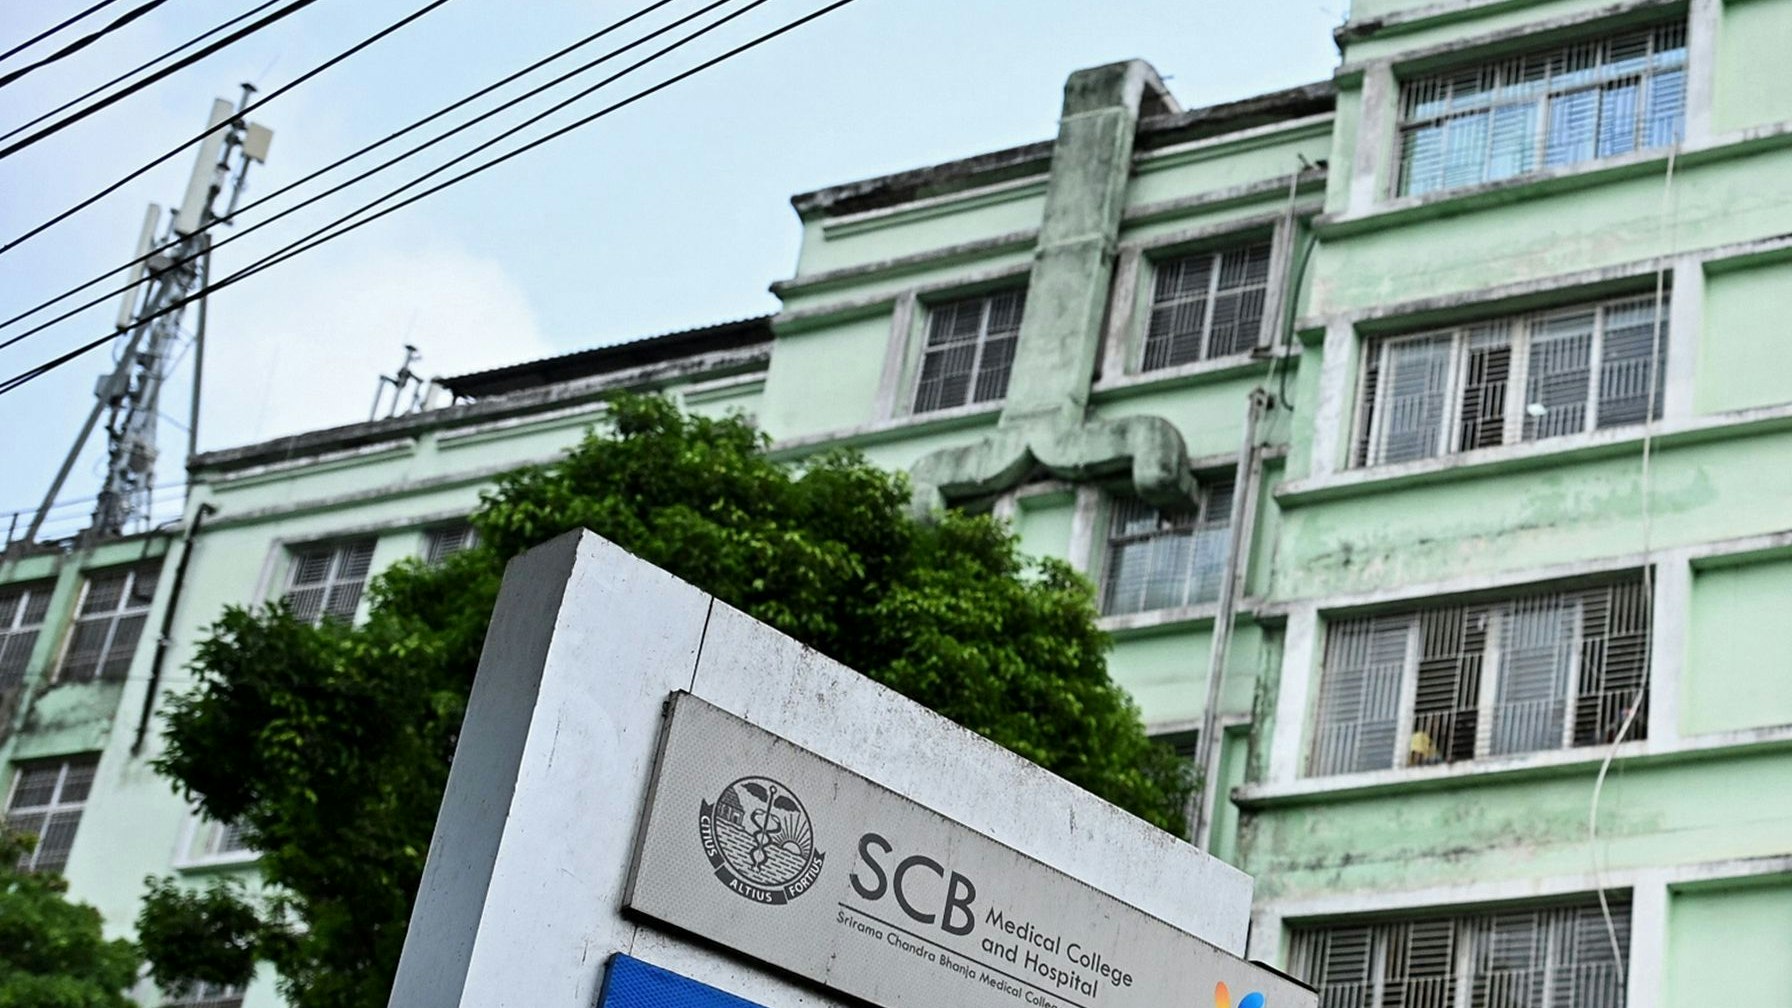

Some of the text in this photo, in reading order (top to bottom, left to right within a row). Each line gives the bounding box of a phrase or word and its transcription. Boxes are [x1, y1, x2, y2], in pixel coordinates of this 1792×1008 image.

[701, 816, 717, 857] CITIUS
[729, 880, 772, 902] ALTIUS
[789, 857, 822, 897] FORTIUS
[849, 832, 976, 936] SCB
[836, 911, 883, 940] Srirama
[887, 932, 936, 962] Chandra
[939, 954, 976, 979] Bhanja
[979, 972, 1022, 999] Medical
[982, 938, 1099, 998] and Hospital
[985, 907, 1133, 987] Medical College
